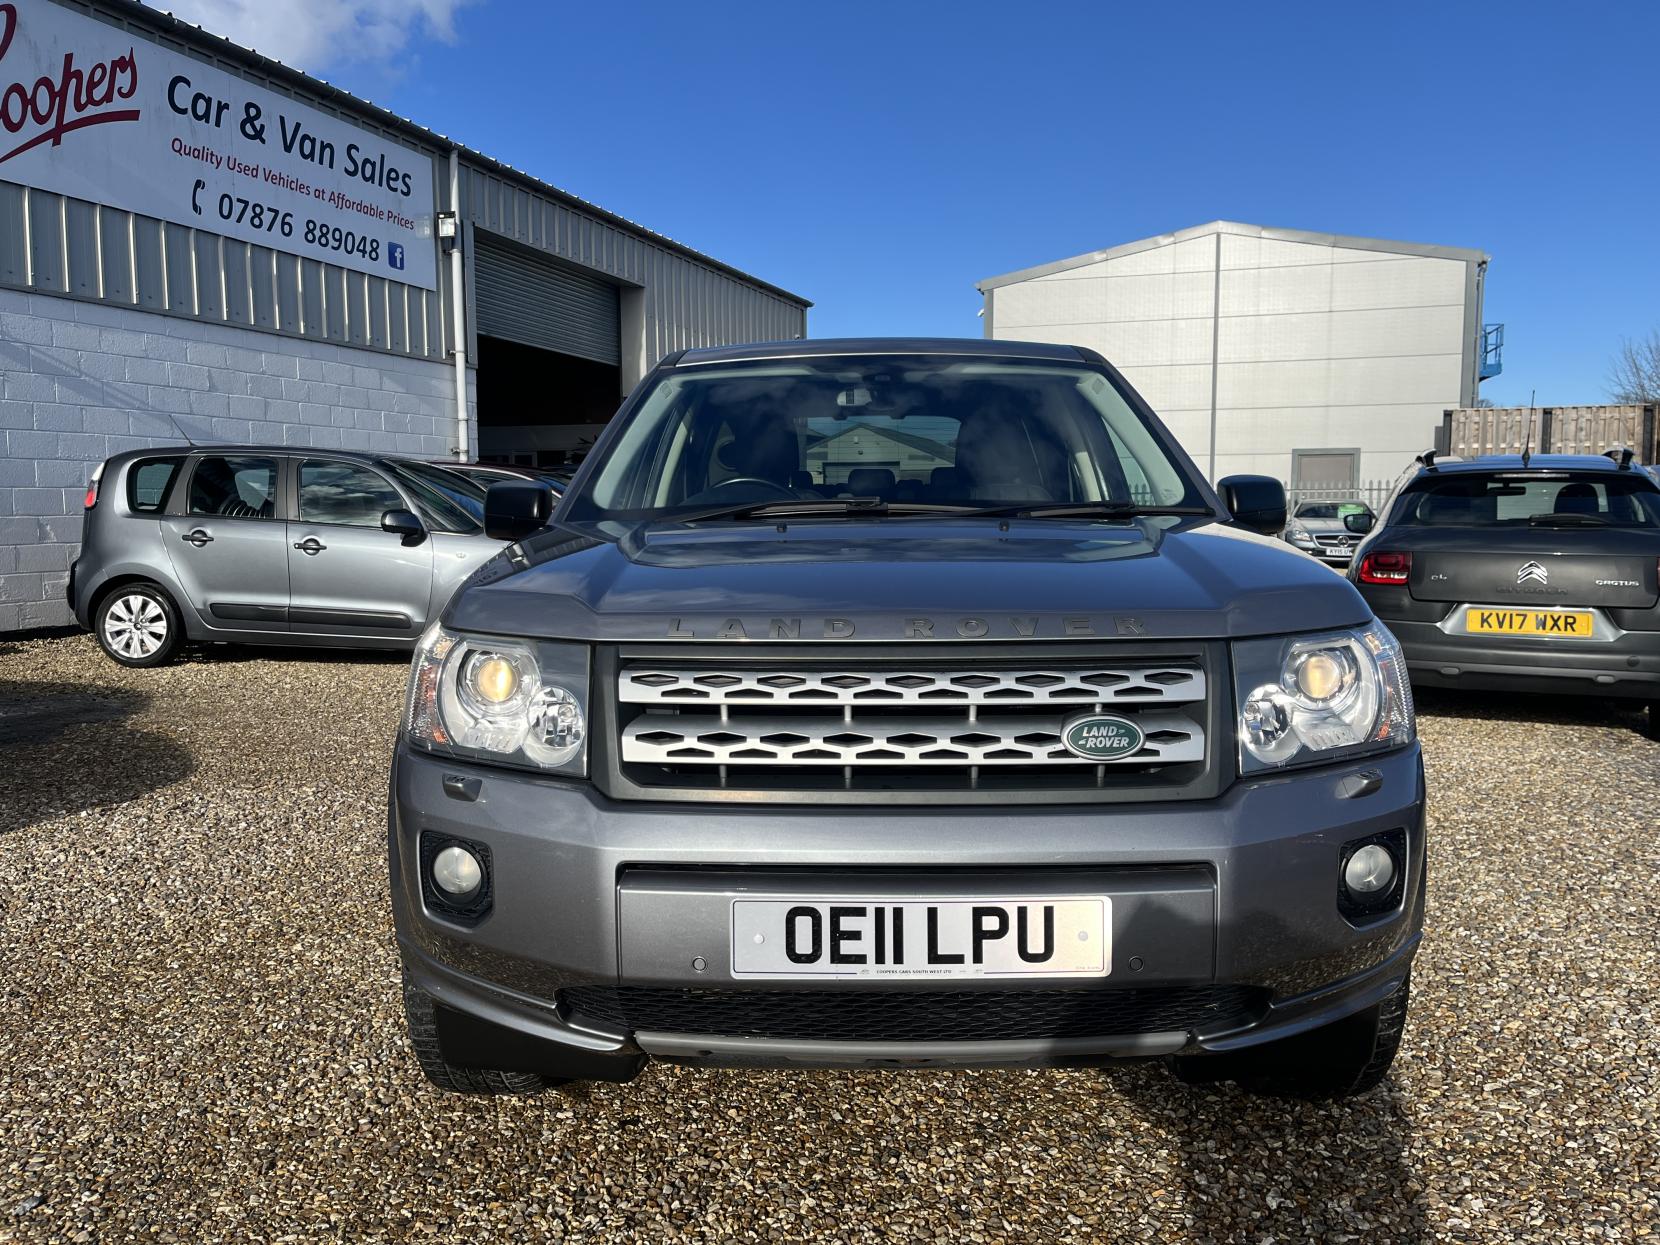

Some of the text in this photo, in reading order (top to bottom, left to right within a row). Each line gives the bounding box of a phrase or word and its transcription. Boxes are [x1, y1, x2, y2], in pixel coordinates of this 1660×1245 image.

[167, 75, 413, 197] Car & Van Sales
[171, 137, 415, 231] Quality Used Vehicles at Affordable Prices
[218, 193, 380, 262] 07876 889048
[665, 615, 1148, 639] LAND ROVER
[1480, 612, 1577, 632] KV17 WXR
[1082, 726, 1118, 737] LAND
[1086, 736, 1130, 748] ROVER
[785, 905, 1055, 965] OE11 LPU
